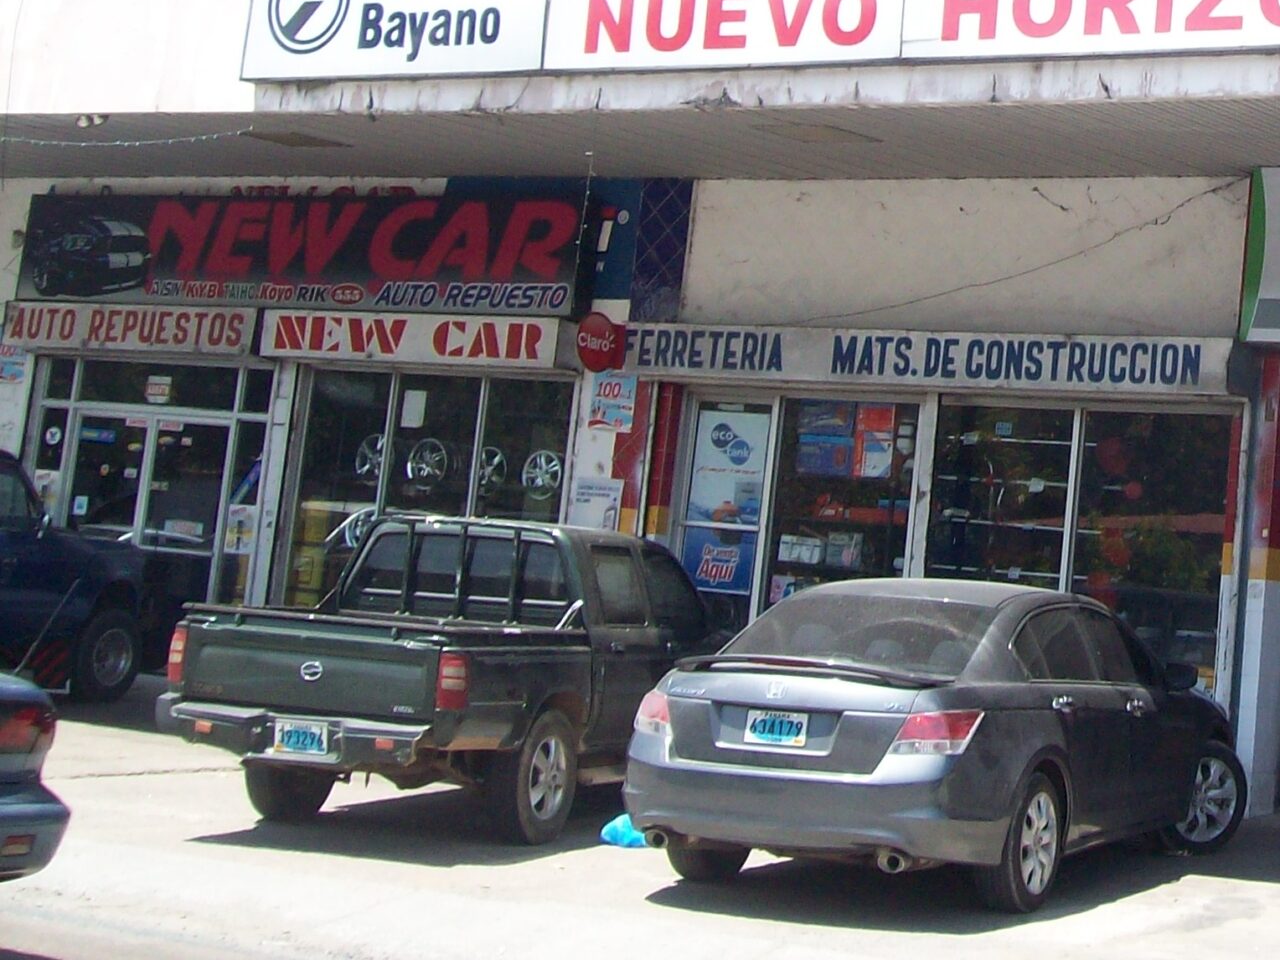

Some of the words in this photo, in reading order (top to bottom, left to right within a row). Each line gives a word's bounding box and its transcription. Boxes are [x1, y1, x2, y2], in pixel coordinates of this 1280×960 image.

[357, 2, 501, 62] Bayano
[149, 200, 368, 279] NEW
[367, 200, 578, 282] CAR
[186, 282, 218, 300] KYB
[259, 282, 294, 302] Koyo
[296, 286, 330, 303] RIK
[373, 282, 438, 308] AUTO
[441, 282, 569, 309] REPUESTO
[9, 307, 77, 340] AUTO
[86, 309, 245, 347] REPUESTOS
[274, 315, 409, 355] NEW
[432, 320, 543, 360] CAR
[577, 331, 611, 352] Claro
[624, 328, 783, 372] FERRETERIA
[831, 335, 917, 378] MATS.
[923, 339, 960, 378] DE
[964, 339, 1201, 386] CONSTRUCCION
[596, 381, 622, 399] 100
[711, 430, 734, 441] eco
[697, 557, 736, 585] Aquí
